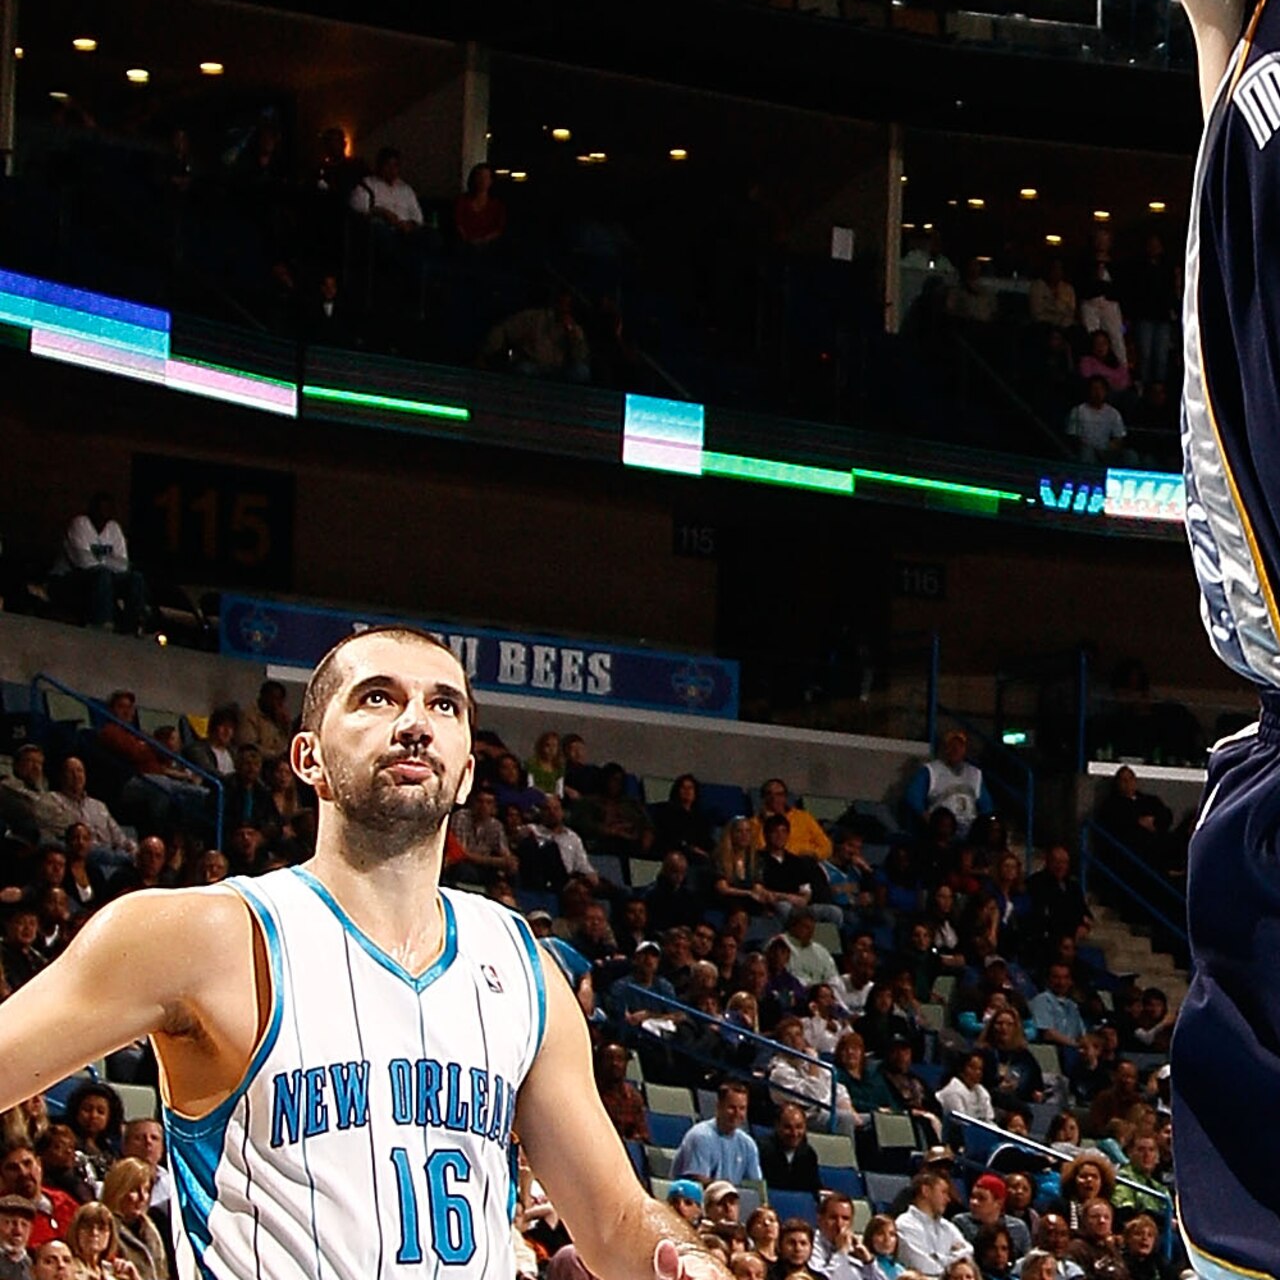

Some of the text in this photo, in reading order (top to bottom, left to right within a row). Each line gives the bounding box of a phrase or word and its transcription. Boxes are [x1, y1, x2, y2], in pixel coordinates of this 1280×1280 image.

[153, 480, 271, 567] 115
[498, 640, 611, 695] BEES
[270, 1060, 371, 1148] NEW
[390, 1147, 476, 1266] 16
